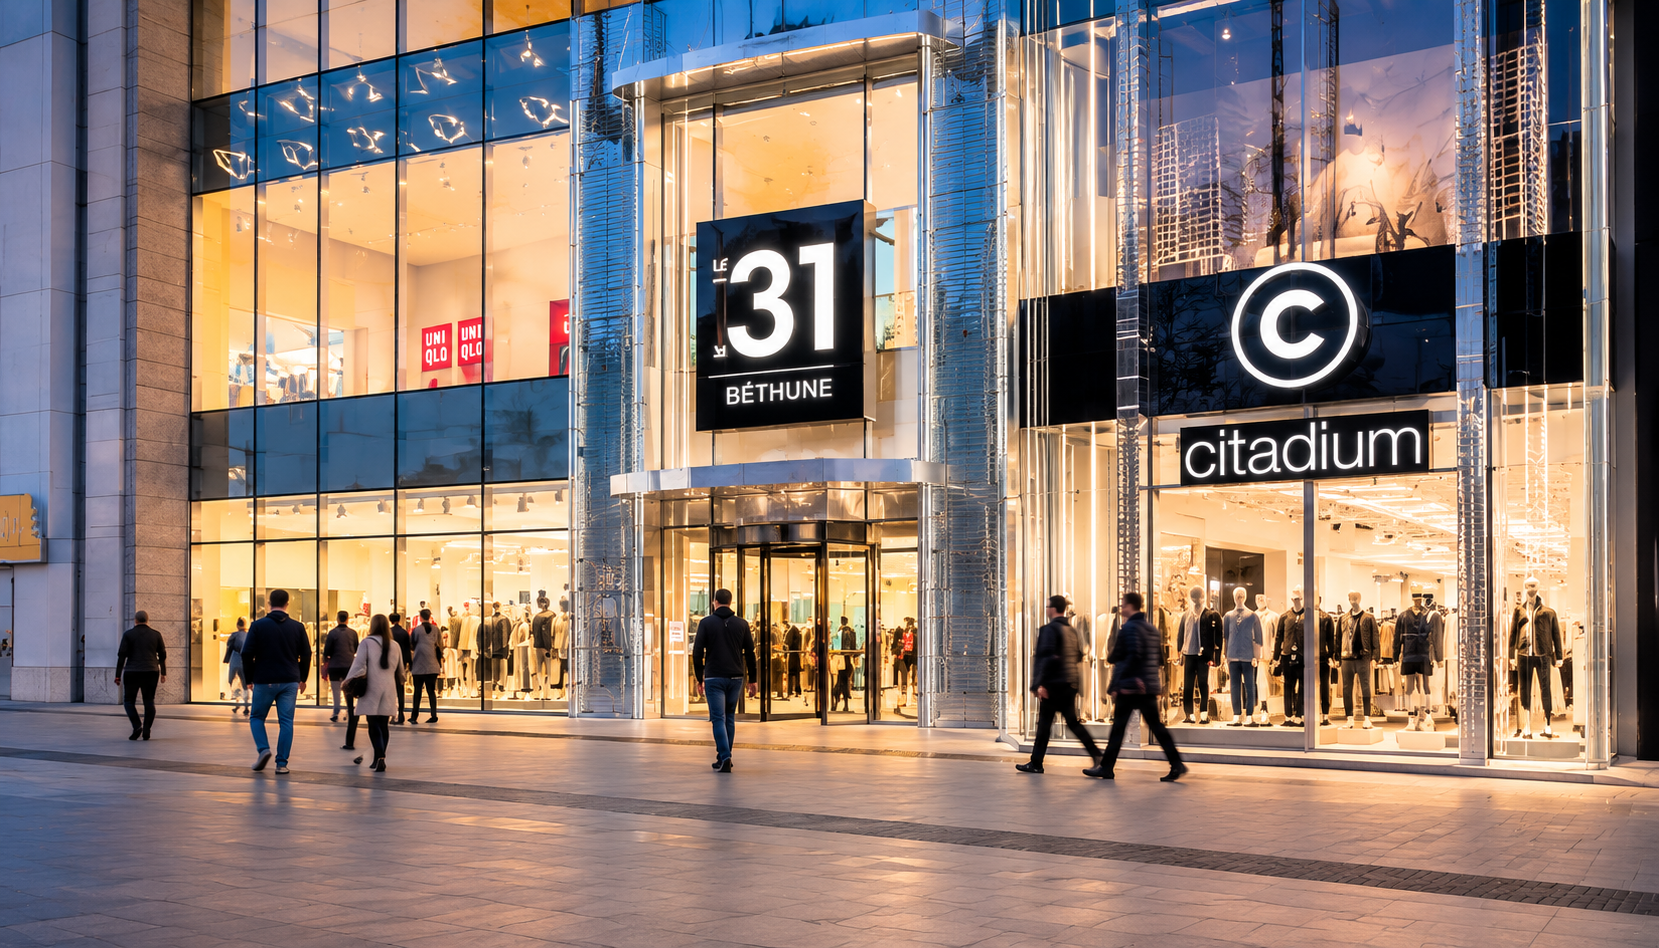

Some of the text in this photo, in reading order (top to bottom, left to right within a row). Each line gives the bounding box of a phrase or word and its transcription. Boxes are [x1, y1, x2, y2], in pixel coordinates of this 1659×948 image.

[727, 242, 835, 358] 31
[425, 329, 446, 347] UNI
[461, 323, 482, 341] UNI
[425, 346, 448, 367] QLO
[461, 341, 483, 362] QLO
[726, 378, 833, 405] BÉTHUNE
[1184, 420, 1422, 478] citadium
